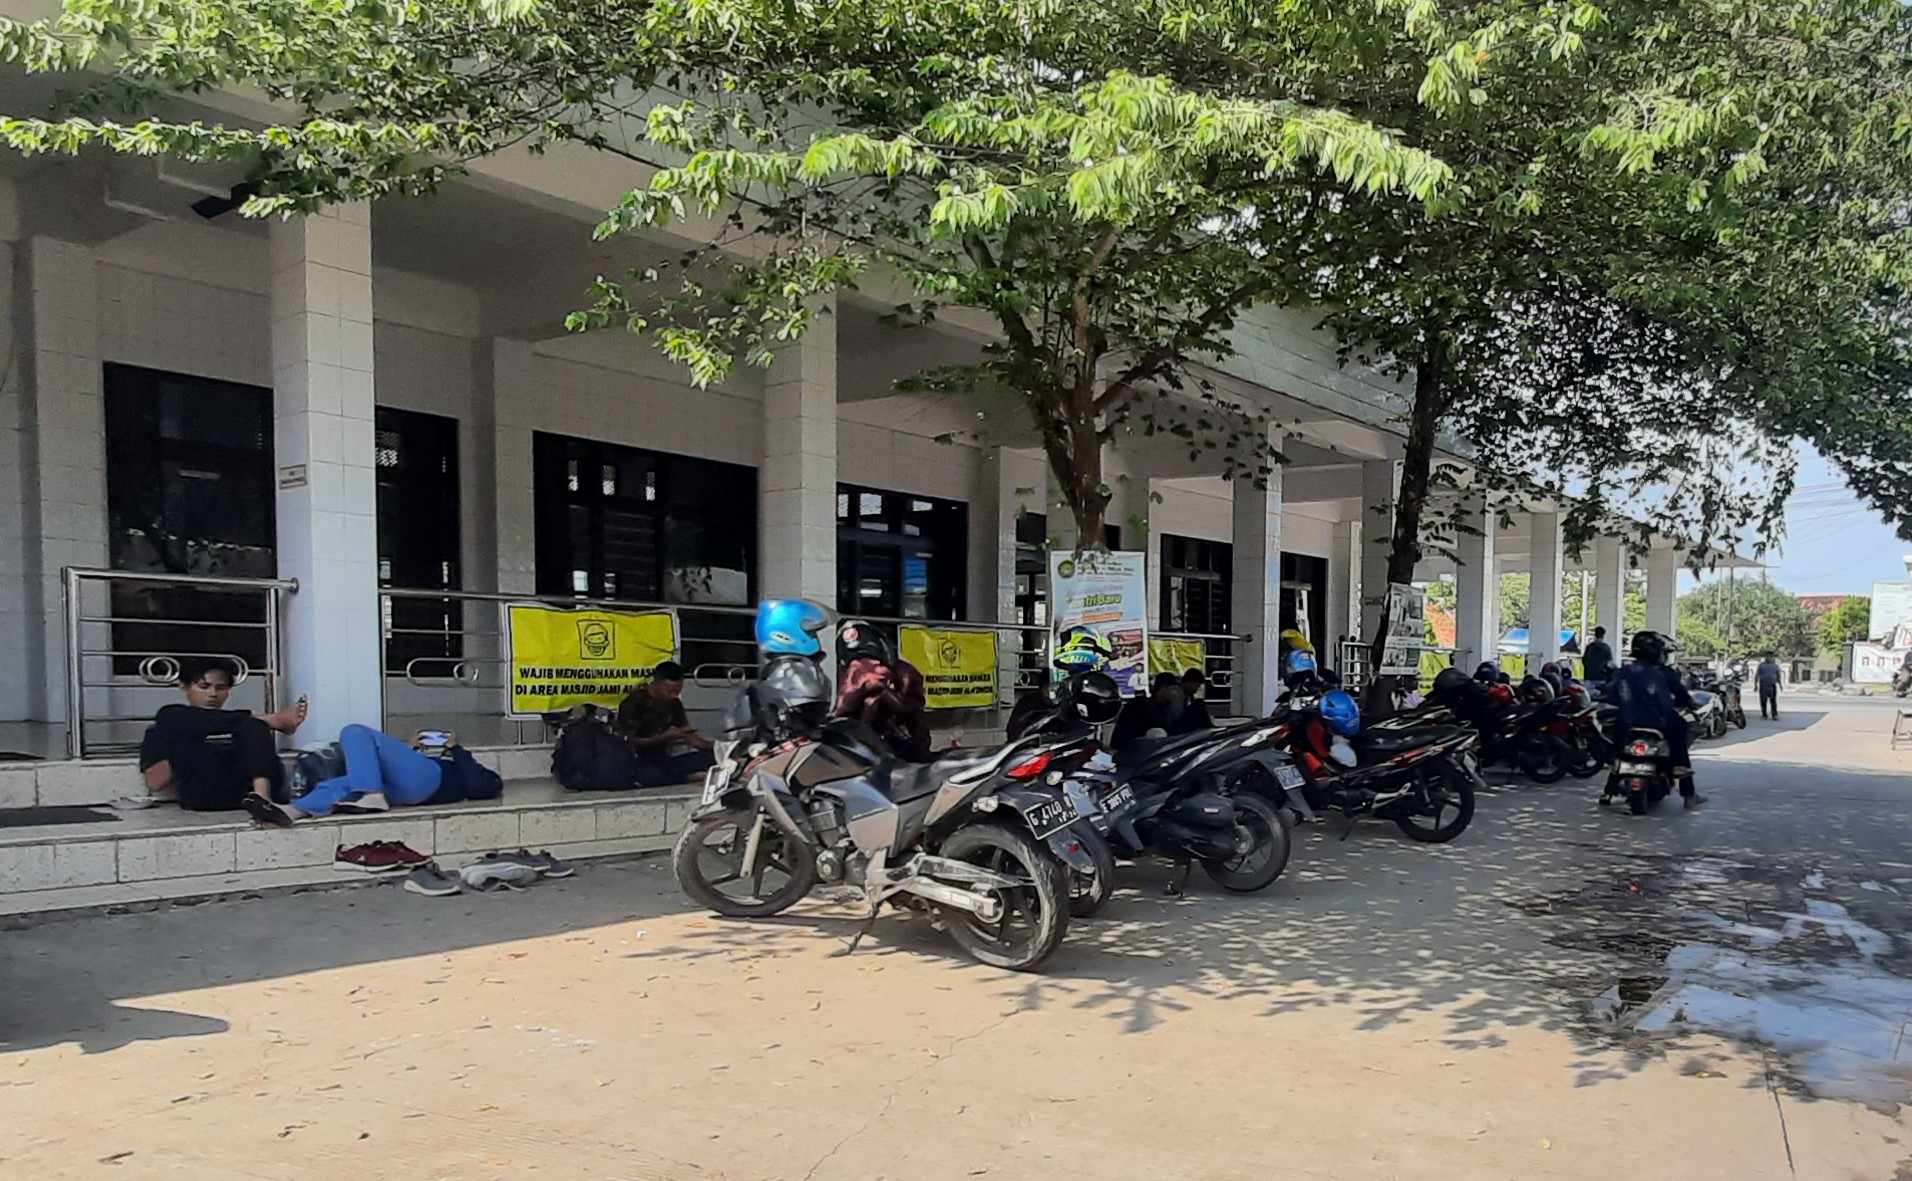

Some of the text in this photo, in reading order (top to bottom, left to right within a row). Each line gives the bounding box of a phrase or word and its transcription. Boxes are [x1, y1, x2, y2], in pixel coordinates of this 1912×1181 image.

[1098, 594, 1122, 605] Baru
[519, 668, 553, 679] WAJIB
[555, 668, 628, 680] MENGGUNAKAN
[515, 685, 527, 695] DI
[529, 684, 558, 696] AREA
[561, 684, 596, 695] MASJID
[597, 684, 621, 695] JAMI
[1029, 796, 1072, 826] G 4740 R
